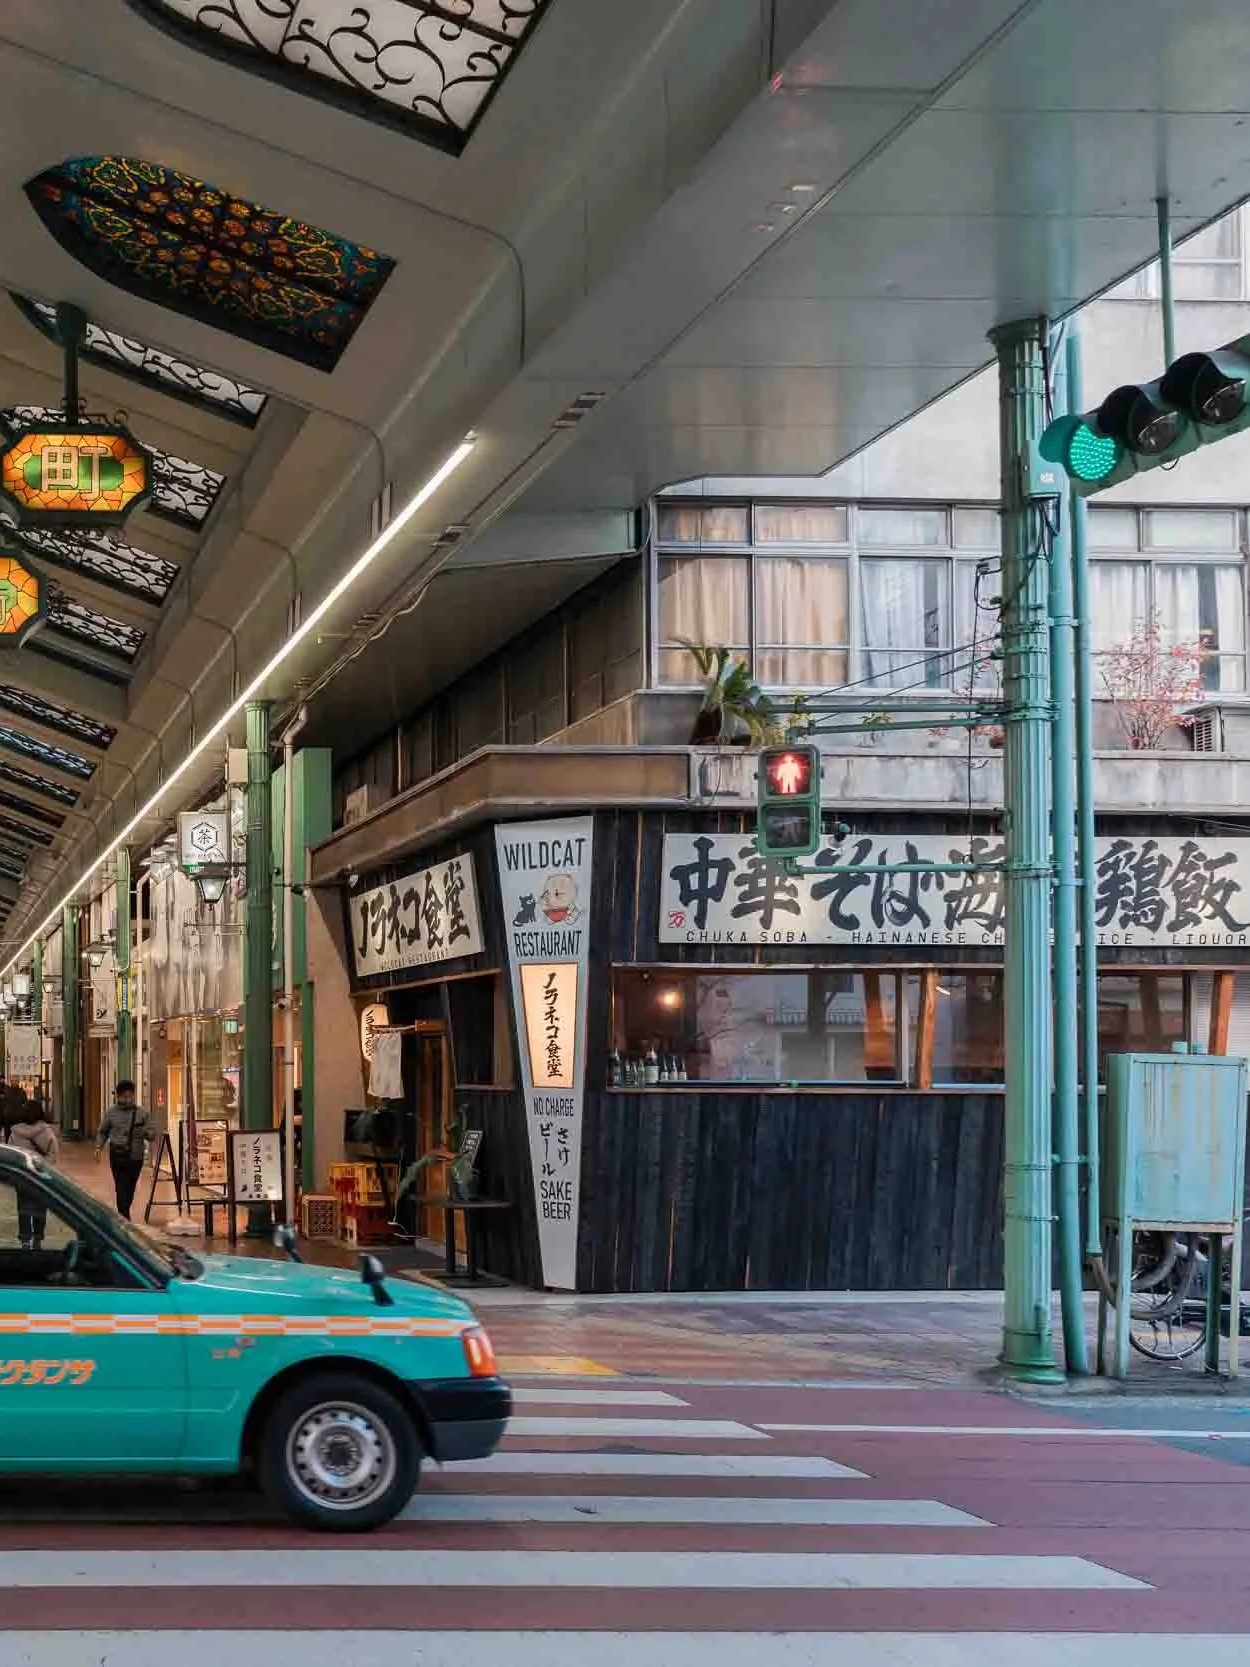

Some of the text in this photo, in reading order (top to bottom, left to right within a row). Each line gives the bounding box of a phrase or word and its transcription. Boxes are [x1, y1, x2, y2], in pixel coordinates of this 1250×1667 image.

[41, 446, 108, 501] 町
[198, 829, 213, 845] 茶
[504, 838, 586, 871] WILDCAT
[358, 861, 470, 958] ノラネコ食堂
[514, 930, 582, 957] RESTAURANT
[686, 931, 747, 942] CHUKA
[760, 931, 807, 942] SOBA
[852, 932, 967, 944] HAINANESE
[543, 972, 564, 1078] ノラネコ食堂
[534, 1097, 574, 1117] NO CHARGE
[540, 1121, 557, 1177] ビール
[558, 1127, 570, 1167] さけ
[253, 1136, 263, 1192] ノラネコ食堂
[541, 1181, 572, 1200] SAKE
[543, 1201, 571, 1219] BEER
